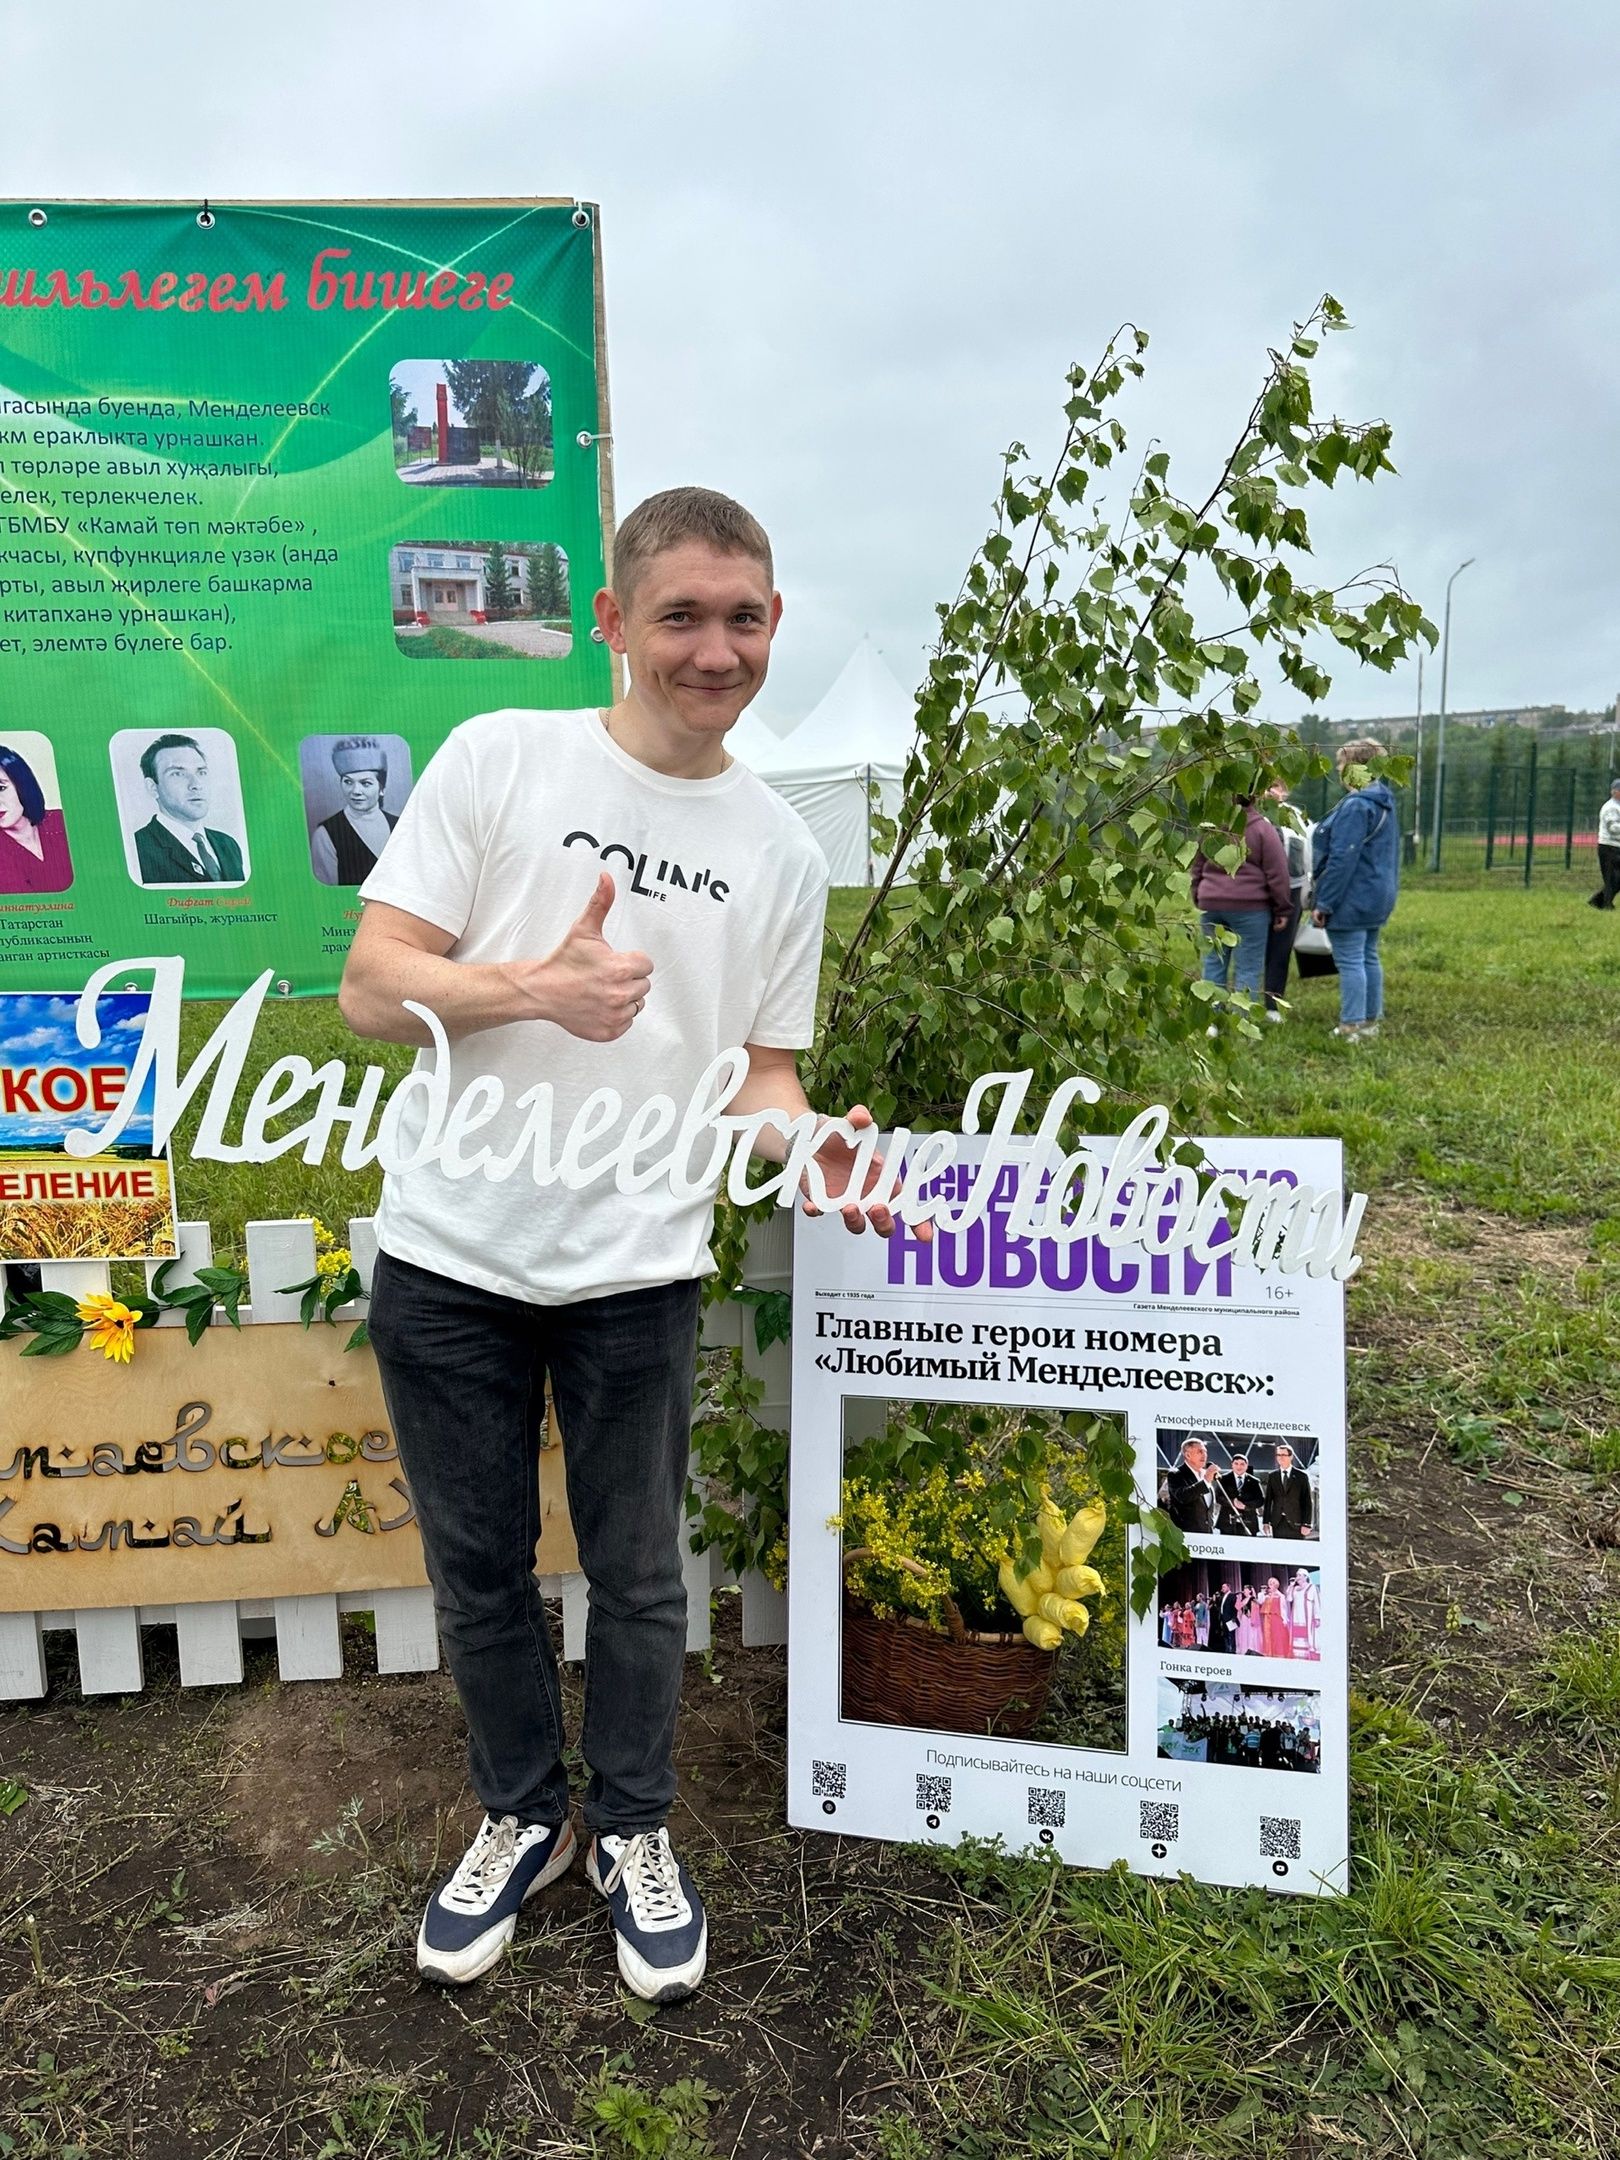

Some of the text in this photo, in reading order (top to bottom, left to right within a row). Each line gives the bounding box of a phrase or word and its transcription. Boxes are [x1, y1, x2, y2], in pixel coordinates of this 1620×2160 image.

[307, 248, 515, 311] бишеге
[0, 397, 331, 420] гасында буенда, Менделеевск
[33, 430, 148, 448] ераклыкта
[154, 430, 264, 449] урнашкан.
[11, 460, 100, 478] төрләре
[106, 461, 160, 476] авыл
[167, 462, 279, 479] хуҗалыгы,
[61, 490, 203, 508] терлекчелек.
[77, 516, 158, 534] «Камай
[164, 521, 200, 535] төп
[73, 545, 226, 567] күпфункцияле
[232, 549, 276, 567] үзәк
[282, 544, 339, 565] (анда
[52, 579, 105, 593] авыл
[111, 579, 201, 594] җирлеге
[208, 575, 313, 593] башкарма
[4, 604, 236, 626] китапханә урнашкан),
[33, 638, 107, 652] элемтә
[114, 633, 184, 654] бүлеге
[190, 632, 233, 653] бар.
[144, 913, 277, 926] Шагыйрь, журналист
[37, 950, 110, 963] артисткасы
[2, 1067, 125, 1112] КОЕ
[0, 1171, 155, 1200] ЕЛЕНИЕ
[1265, 1287, 1294, 1301] 16+
[1157, 1304, 1213, 1313] Менделеевского
[1214, 1307, 1273, 1316] муниципального
[815, 1311, 1223, 1362] Главные герои номера
[815, 1347, 1275, 1397] «Любимый Менделеевск»:
[1154, 1414, 1311, 1432] Атмосферный Менделеевск
[1160, 1660, 1232, 1676] Гонка героев
[926, 1749, 1182, 1792] Подписывайтесь на наши соцсети
